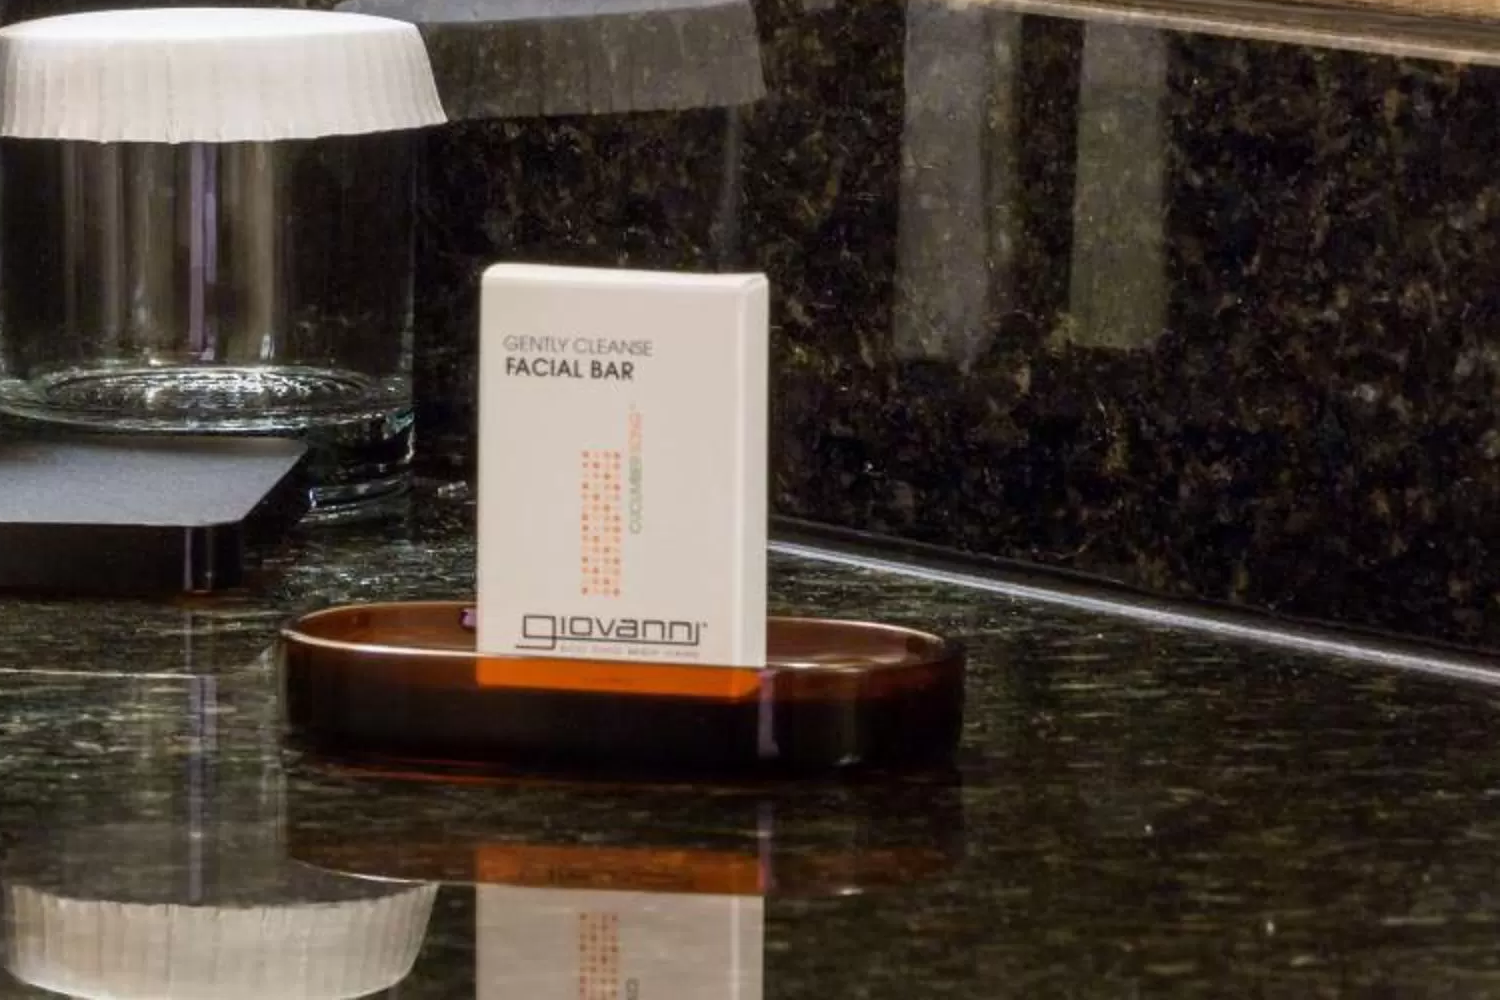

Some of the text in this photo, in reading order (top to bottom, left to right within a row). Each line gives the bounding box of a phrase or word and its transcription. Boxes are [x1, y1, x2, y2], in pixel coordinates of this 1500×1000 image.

[503, 335, 652, 358] GENTLY CLEANSE
[505, 356, 635, 381] FACIAL BAR
[514, 614, 701, 650] giovanni
